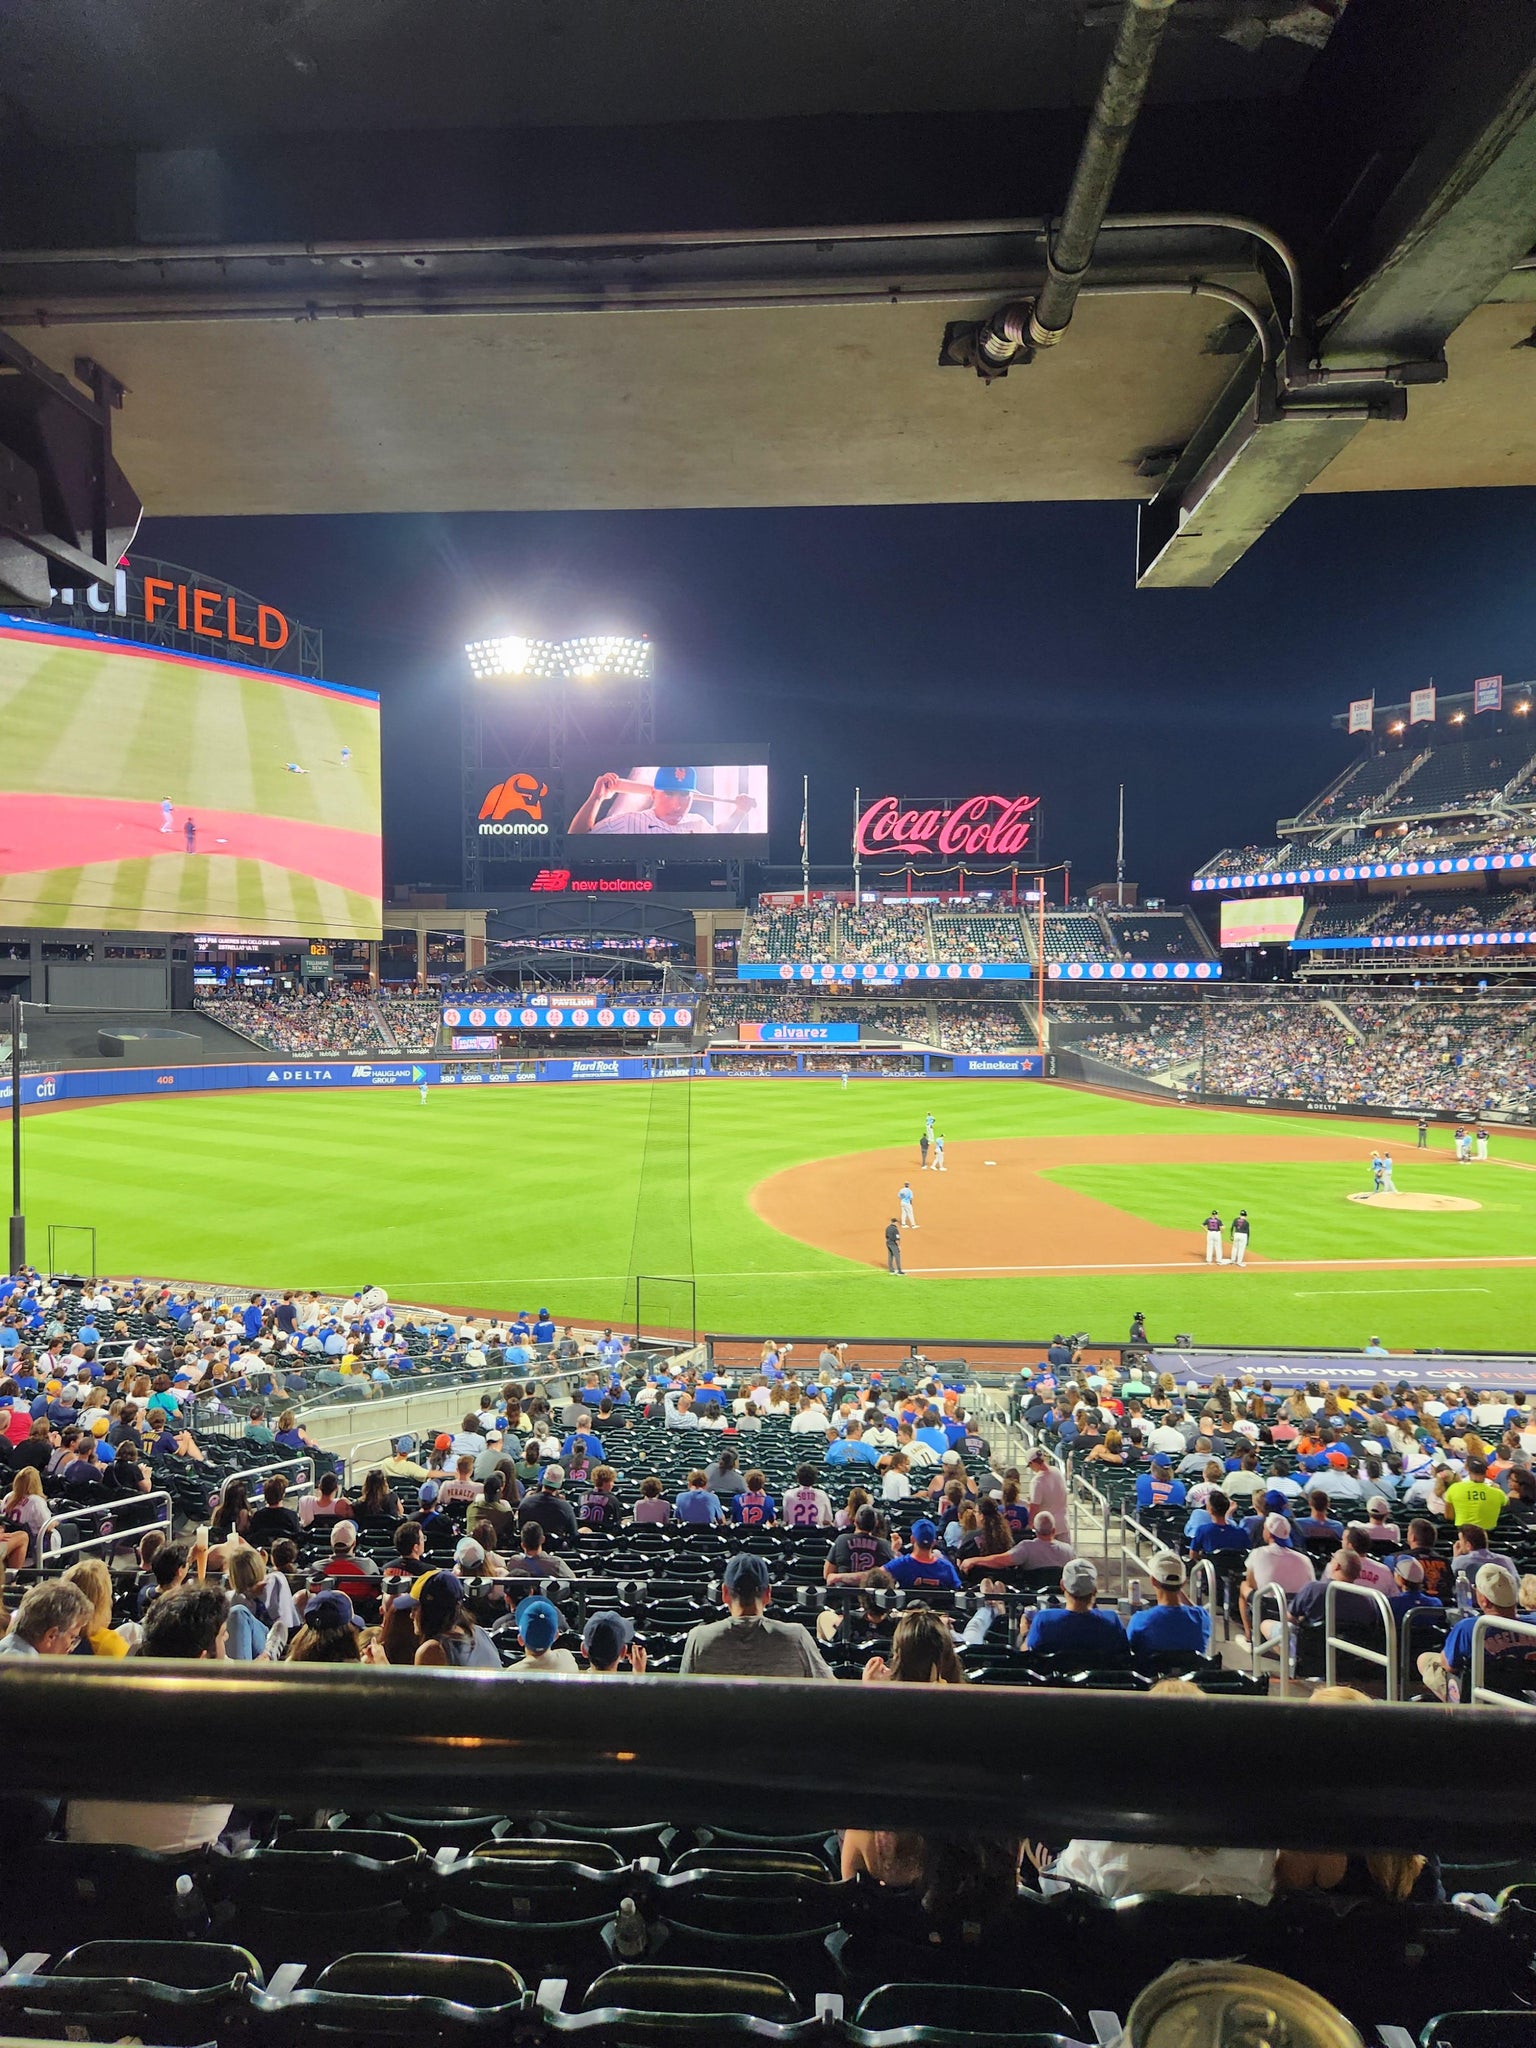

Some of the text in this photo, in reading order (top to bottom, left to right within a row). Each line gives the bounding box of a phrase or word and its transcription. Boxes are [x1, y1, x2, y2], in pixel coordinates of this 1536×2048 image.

[144, 576, 289, 650] FIELD
[478, 822, 549, 836] moomoo
[855, 795, 1041, 855] Coca-Cola
[571, 878, 653, 892] new balance
[552, 997, 594, 1006] PAVILION
[774, 1025, 828, 1038] alvarez
[572, 1060, 619, 1073] Hard Rock
[968, 1060, 1019, 1070] Heineken
[156, 1076, 174, 1084] 408
[283, 1070, 332, 1081] DELTA
[440, 1075, 456, 1083] 380
[36, 1078, 56, 1098] citi
[1313, 1103, 1337, 1111] DELTA
[1236, 1365, 1377, 1376] welcome
[1382, 1369, 1419, 1377] to
[1425, 1368, 1479, 1379] citi
[447, 1488, 475, 1499] PERALTA
[796, 1491, 816, 1502] SOTO
[1467, 1490, 1487, 1501] 120
[741, 1506, 763, 1525] 12
[793, 1503, 819, 1525] 22
[850, 1551, 875, 1572] 12
